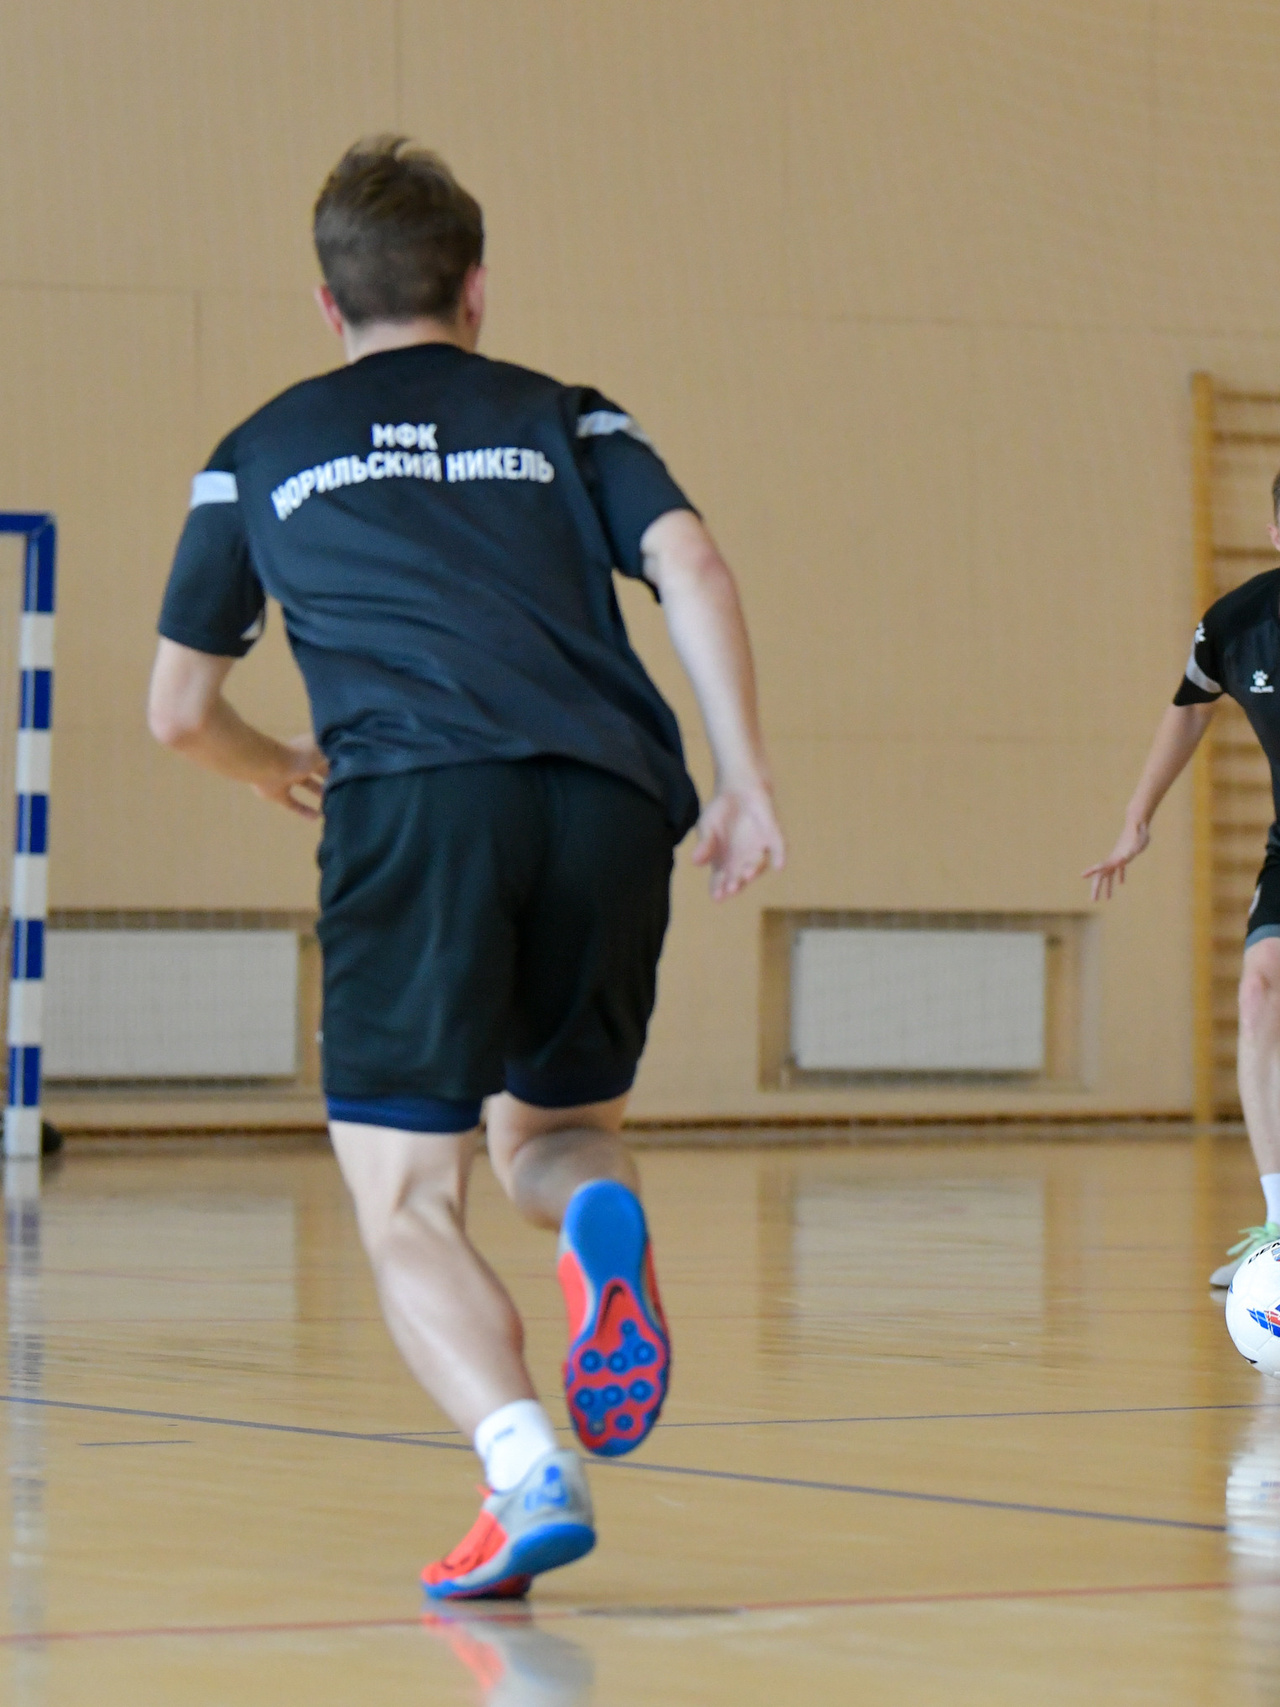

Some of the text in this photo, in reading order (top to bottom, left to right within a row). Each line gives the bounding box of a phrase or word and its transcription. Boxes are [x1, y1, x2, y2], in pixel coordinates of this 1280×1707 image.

[371, 423, 438, 450] МФК
[271, 447, 555, 521] НОРИЛЬСКИЙ НИКЕЛЬ
